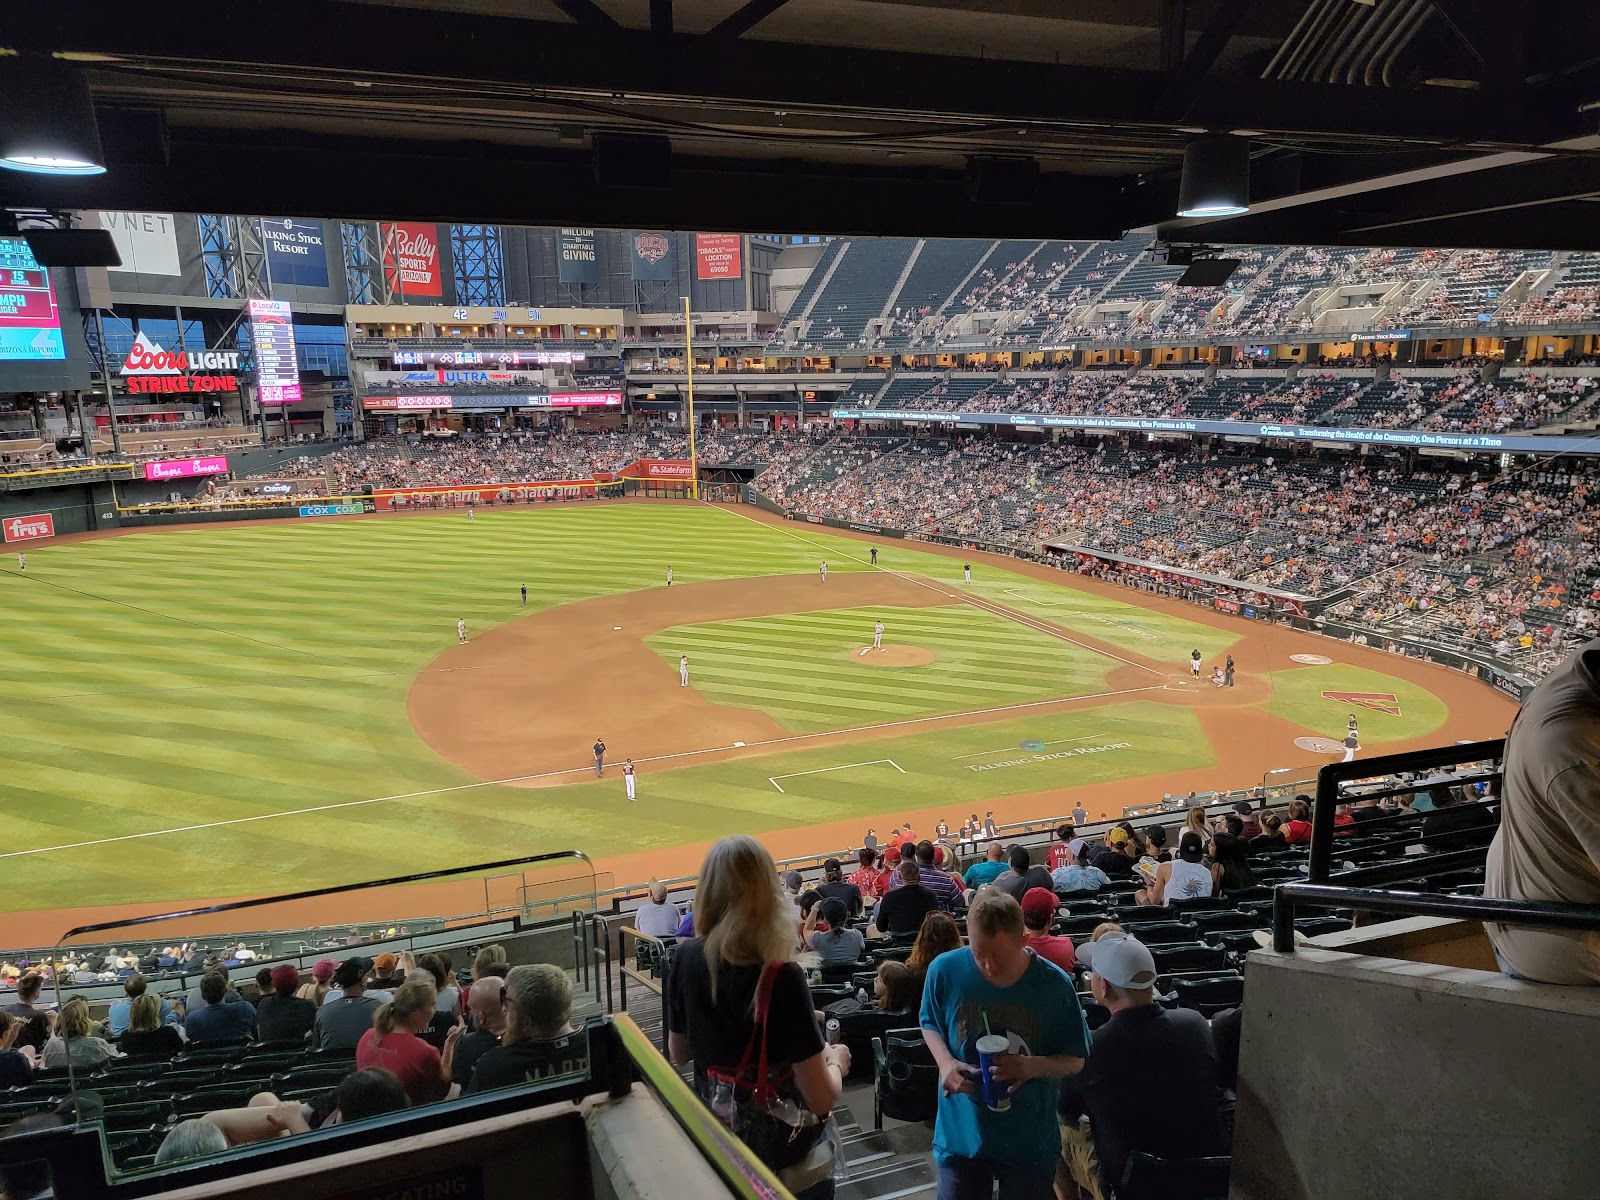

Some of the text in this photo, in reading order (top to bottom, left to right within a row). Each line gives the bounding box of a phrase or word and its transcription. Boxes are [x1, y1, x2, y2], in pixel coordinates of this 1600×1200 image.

[298, 232, 322, 245] STICK
[273, 240, 309, 255] RESORT
[393, 229, 436, 266] Bally
[563, 243, 594, 251] CHARITABLE
[563, 250, 596, 261] GIVING
[400, 257, 427, 270] SPORTS
[12, 271, 25, 280] 15
[402, 271, 428, 281] ARIZONA
[453, 309, 468, 320] 42
[492, 310, 508, 320] 20
[125, 342, 240, 370] Coors LIGHT
[446, 372, 489, 382] ULTRA
[127, 375, 238, 393] STRIKE ZONE
[1299, 428, 1335, 438] Transforming
[1335, 430, 1344, 438] the
[1345, 430, 1365, 439] Health
[1365, 432, 1373, 440] of
[1384, 433, 1420, 443] Community,
[1421, 435, 1435, 443] One
[1436, 436, 1461, 445] Person
[1479, 437, 1501, 446] Time
[308, 505, 356, 515] COX COX
[965, 742, 1132, 772] TALKING STICK RESORT
